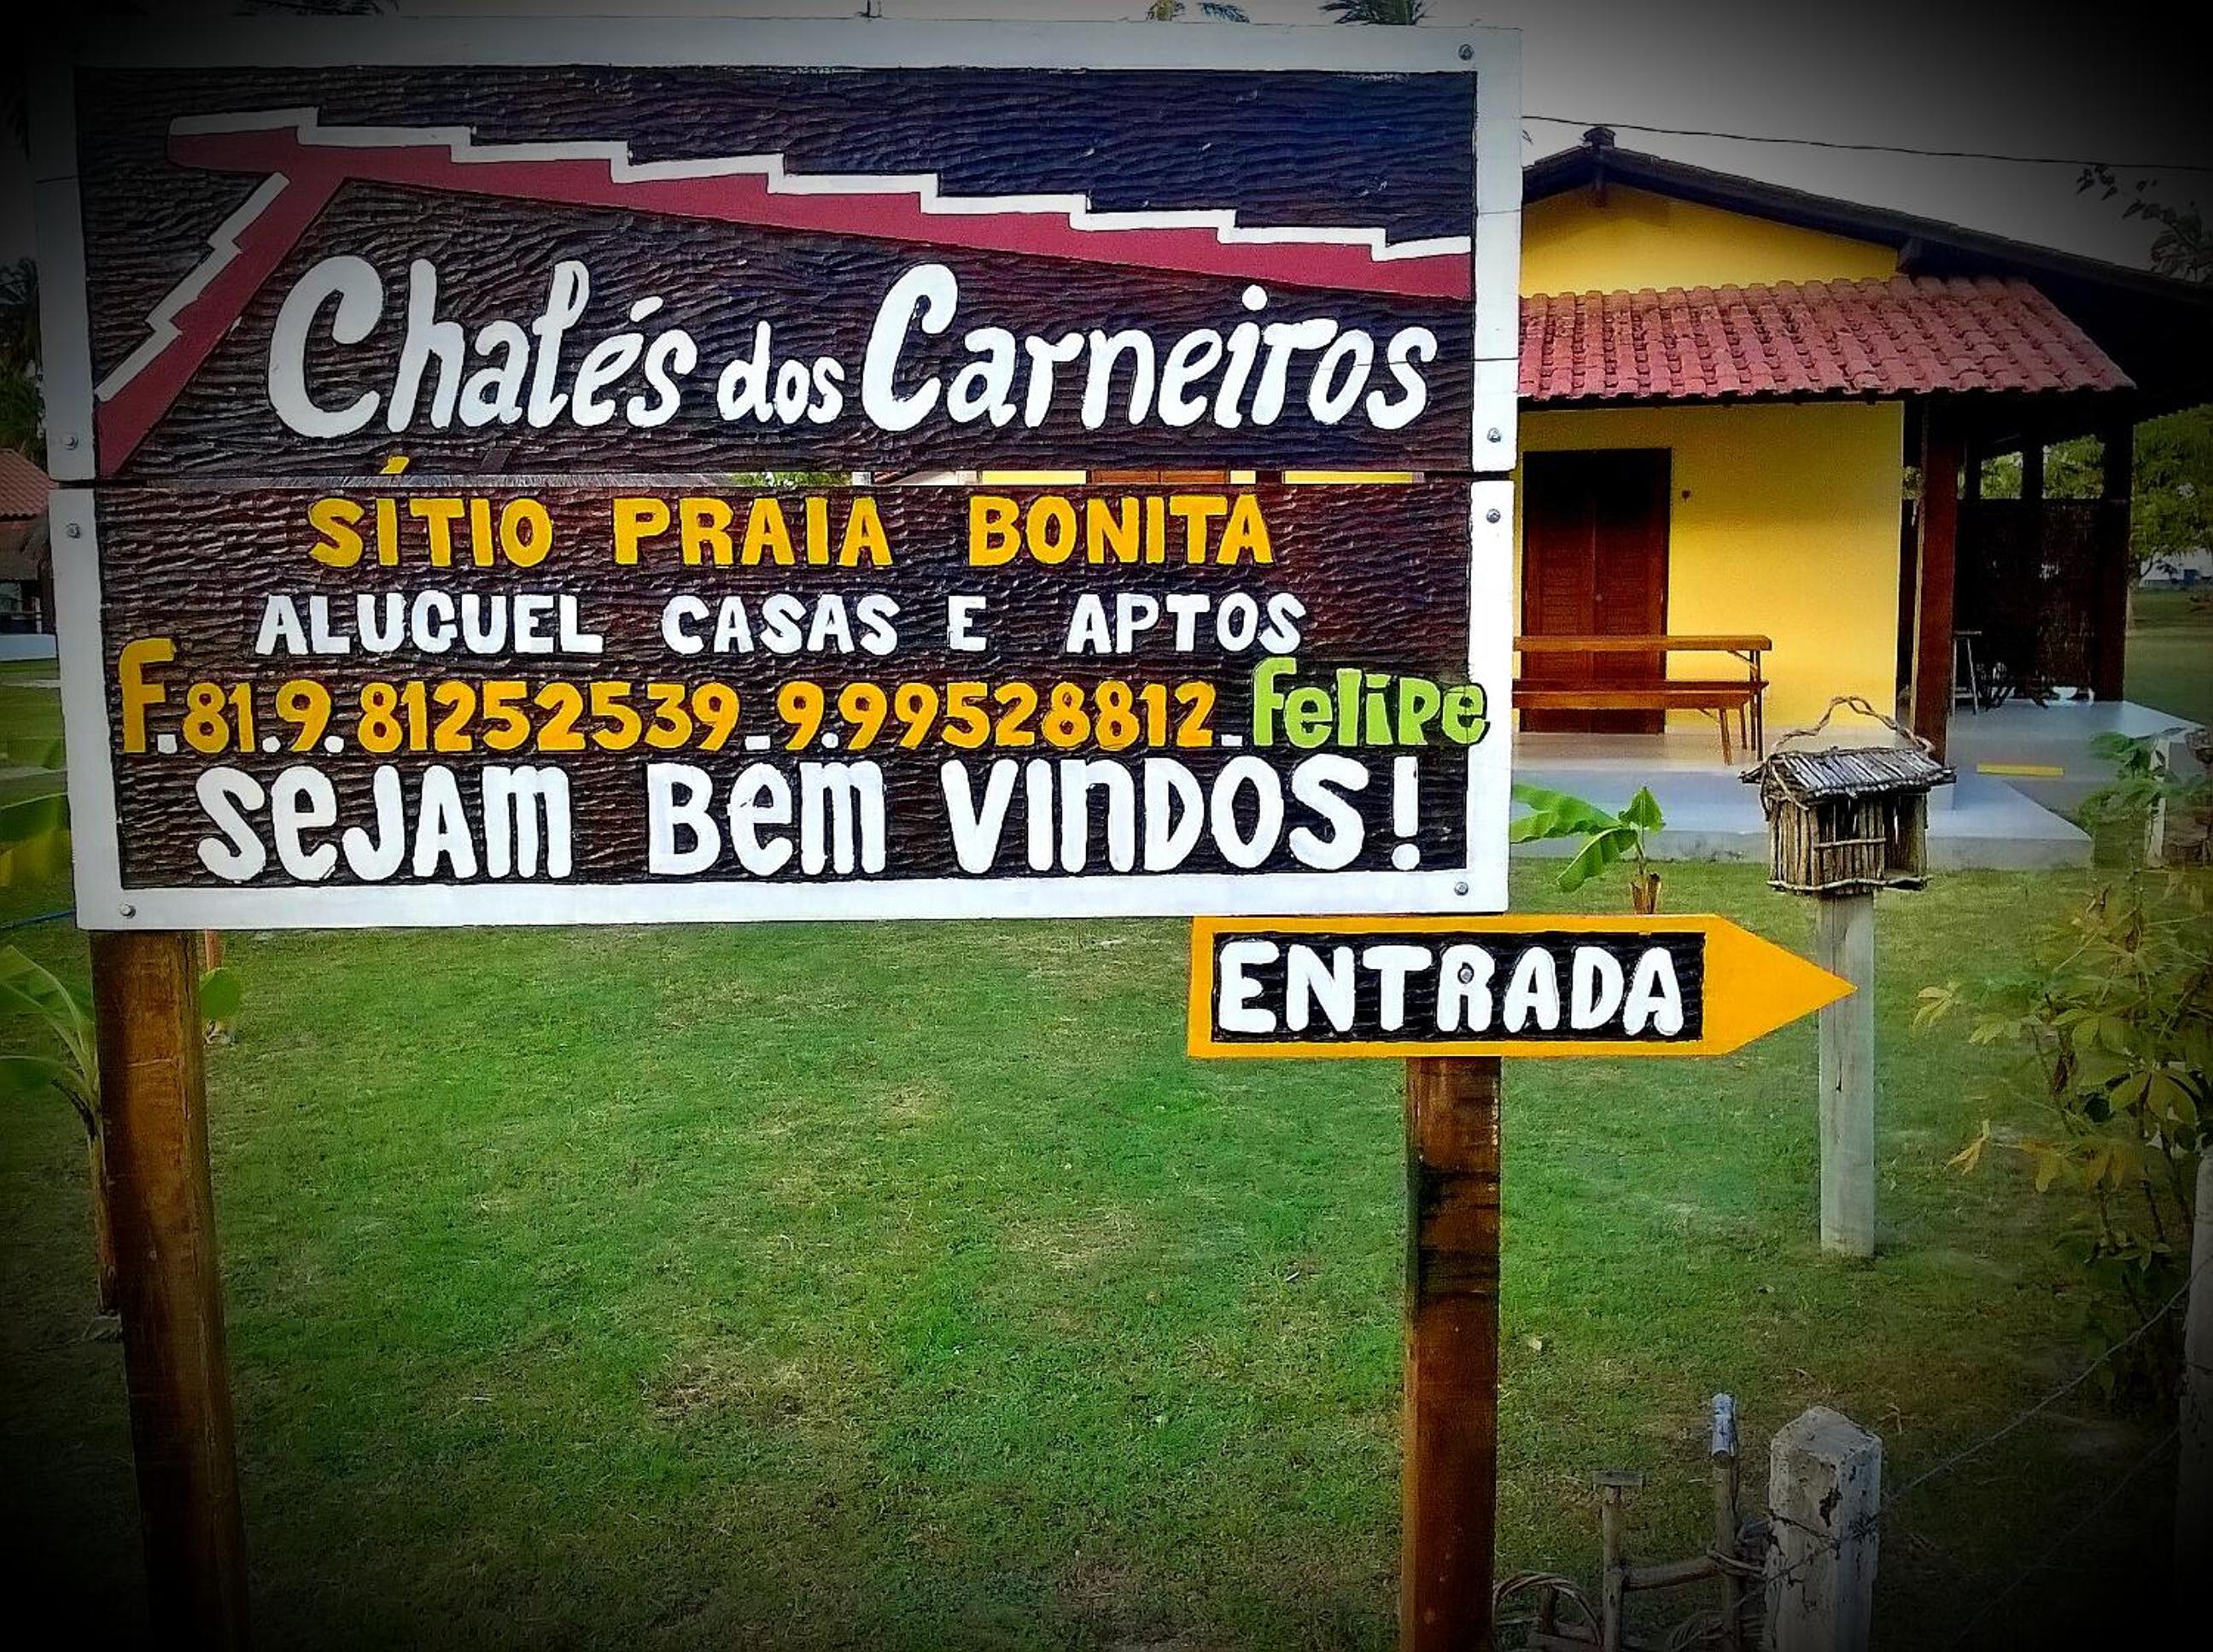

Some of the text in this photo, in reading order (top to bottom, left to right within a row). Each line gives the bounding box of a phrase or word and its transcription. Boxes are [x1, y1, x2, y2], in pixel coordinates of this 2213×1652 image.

[267, 256, 1438, 438] Chalés dos Carneiros
[308, 456, 1273, 568] SÍTIO PRAIA BONITA
[255, 589, 1306, 657] ALUGUEL CASAS E APTOS
[1217, 940, 1685, 1036] ENTRADA
